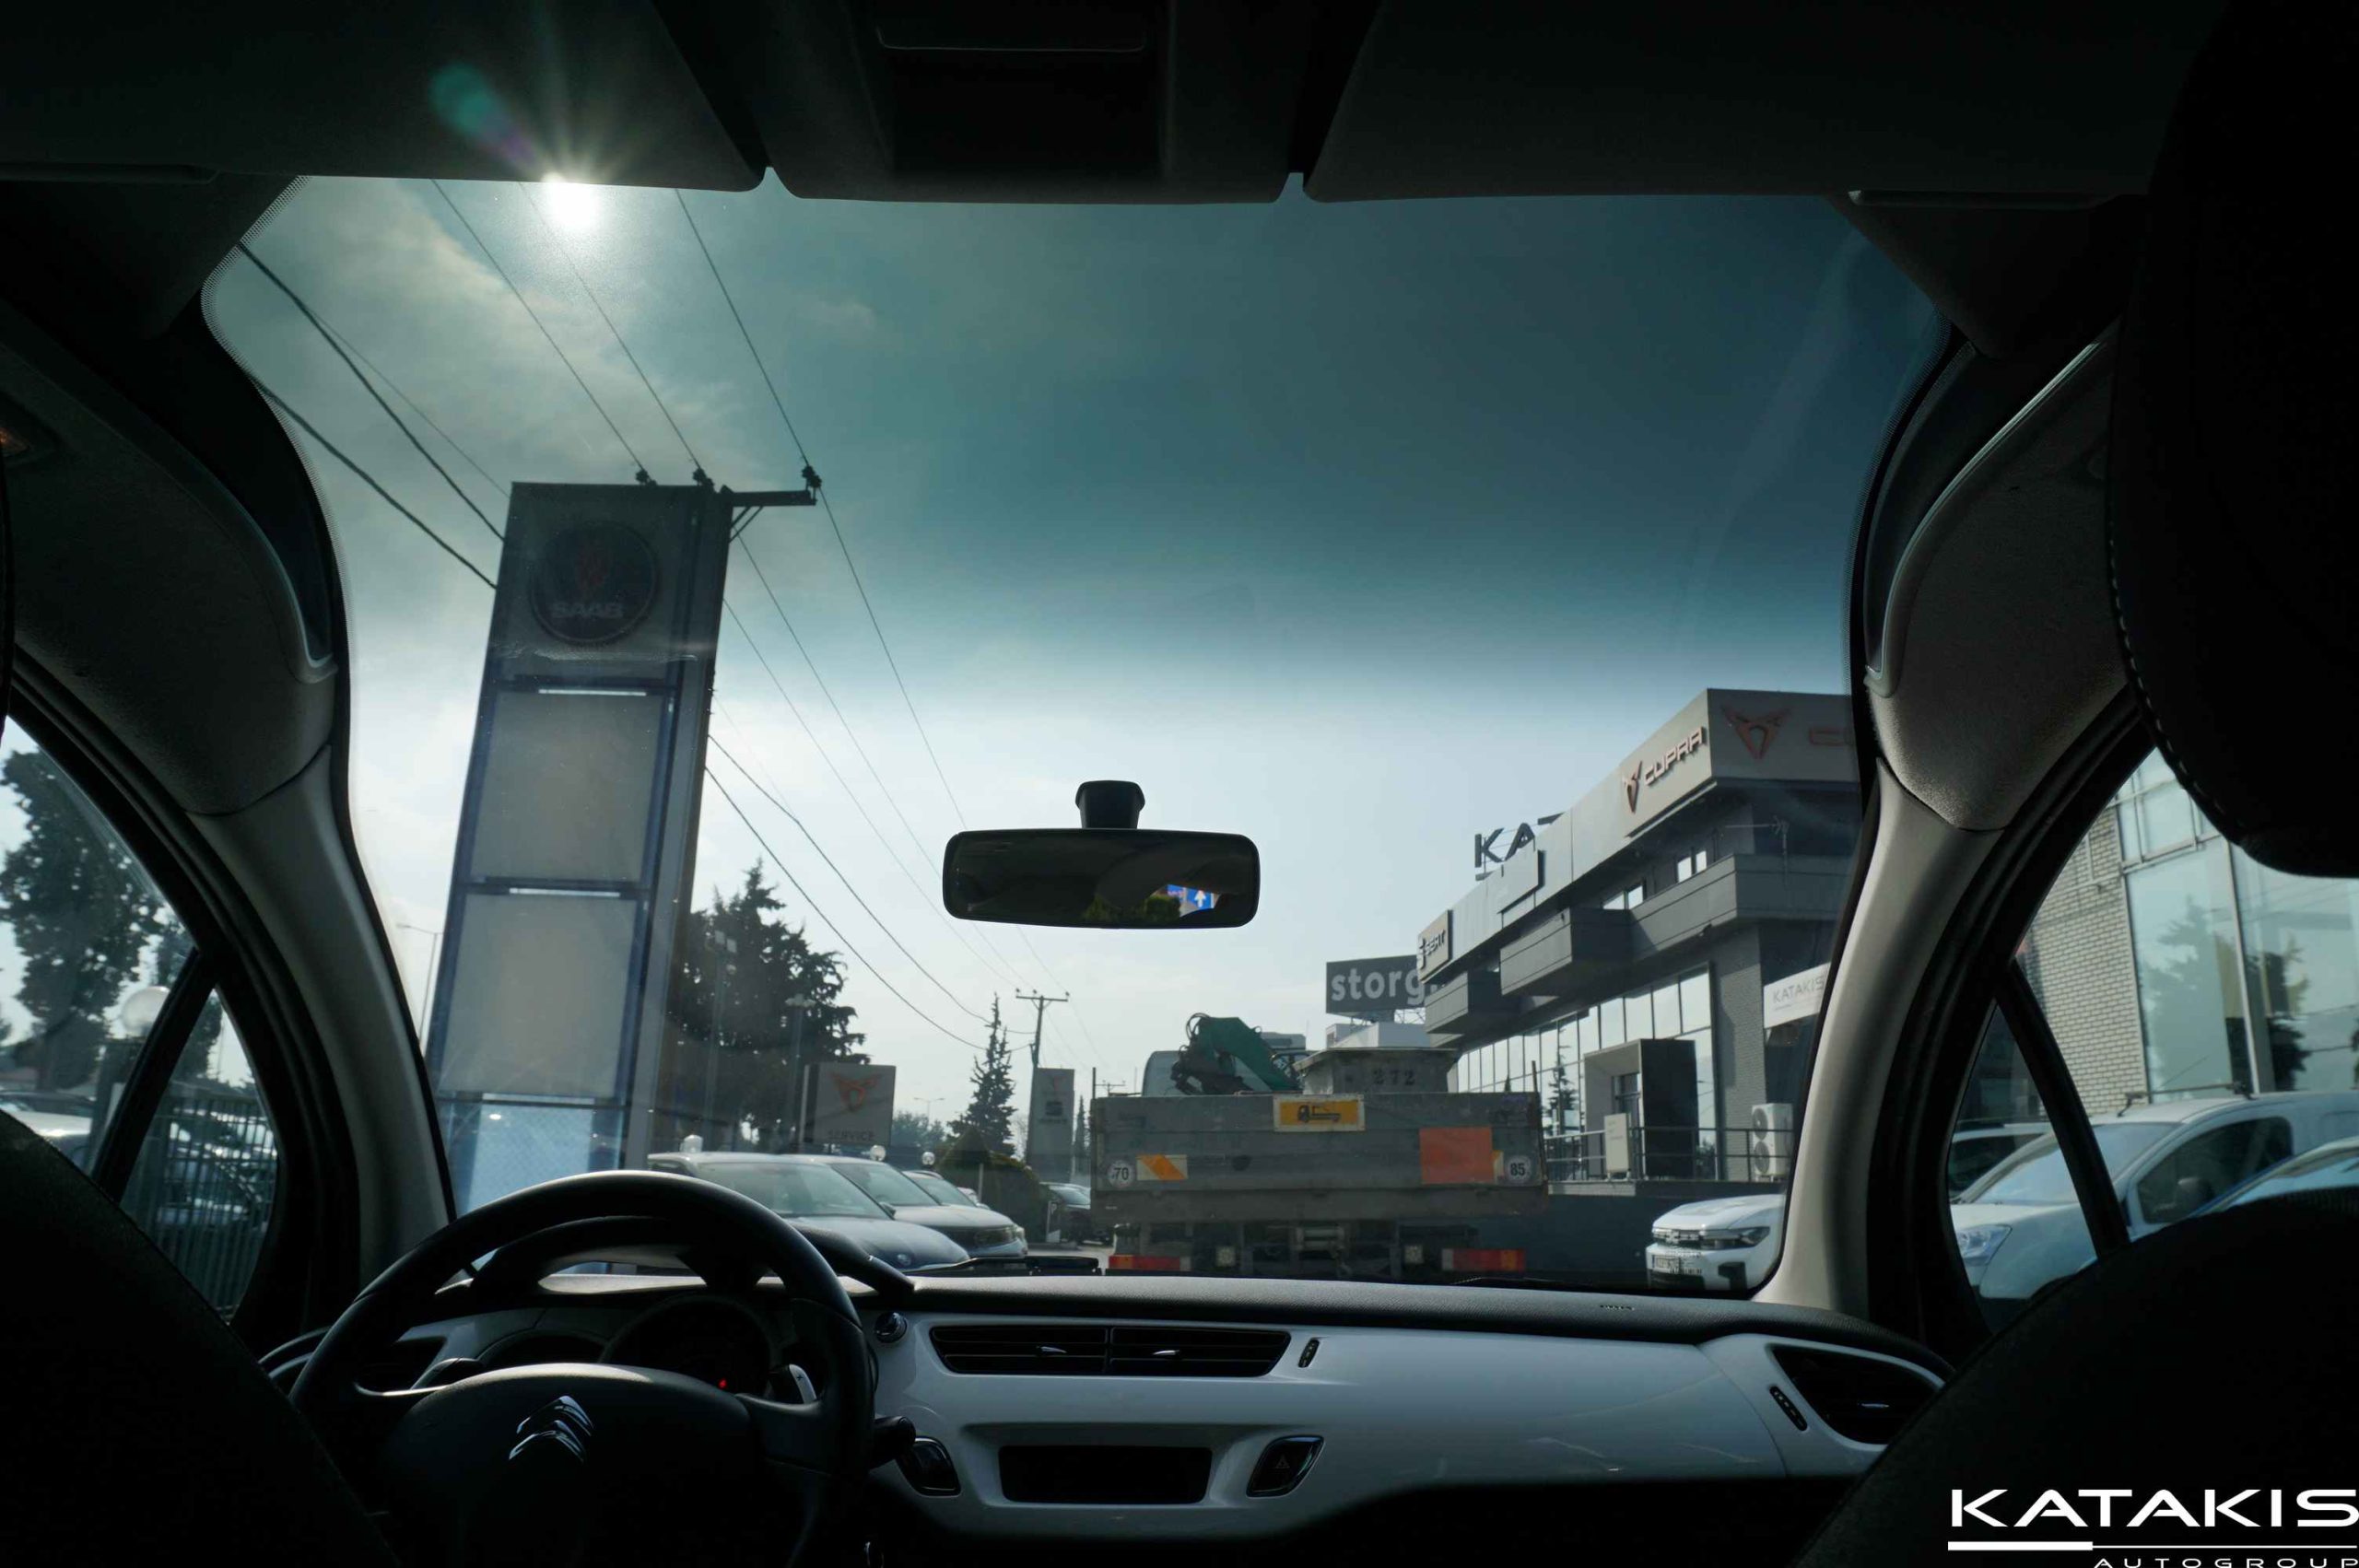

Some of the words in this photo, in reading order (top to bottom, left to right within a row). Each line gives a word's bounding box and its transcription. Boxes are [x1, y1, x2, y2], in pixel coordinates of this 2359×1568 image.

[1644, 726, 1706, 783] CUPRA
[1771, 977, 1824, 1004] KATAKIS
[1113, 1167, 1129, 1180] 70
[1510, 1163, 1525, 1176] 85
